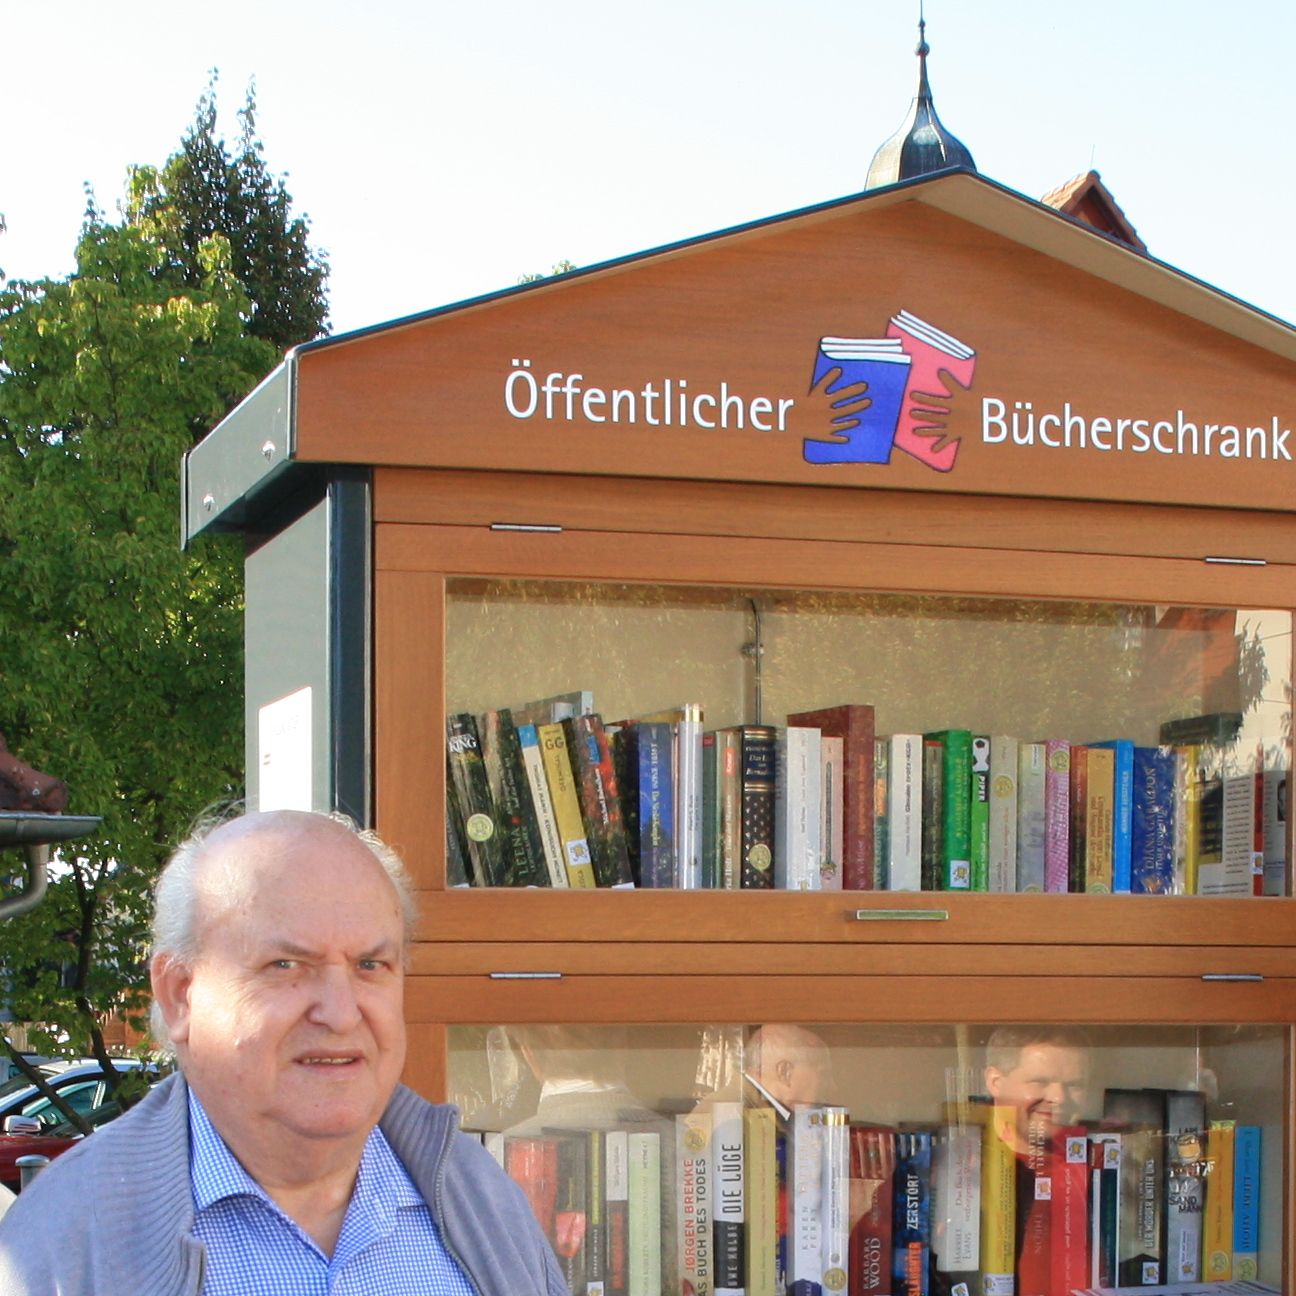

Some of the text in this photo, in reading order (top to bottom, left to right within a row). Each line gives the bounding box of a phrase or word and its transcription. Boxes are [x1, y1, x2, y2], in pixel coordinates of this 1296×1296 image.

[504, 360, 1292, 462] Öffentlicher Bücherschrank
[448, 736, 478, 753] KING
[978, 775, 987, 801] PIPER
[510, 826, 529, 875] LEENA
[1144, 832, 1155, 870] DIANA
[1027, 1120, 1036, 1170] SULLIVAN
[1036, 1120, 1045, 1169] MICHAEL
[695, 1158, 707, 1203] TODES
[717, 1143, 742, 1214] DIE LÜGE
[906, 1173, 919, 1231] ZERSTÖRT
[683, 1159, 695, 1272] JØRGEN BREKKE
[696, 1208, 707, 1234] DES
[1143, 1159, 1154, 1248] DER MÖRDER UNTER UNS
[696, 1239, 707, 1277] BUCH
[869, 1238, 881, 1289] WOOD
